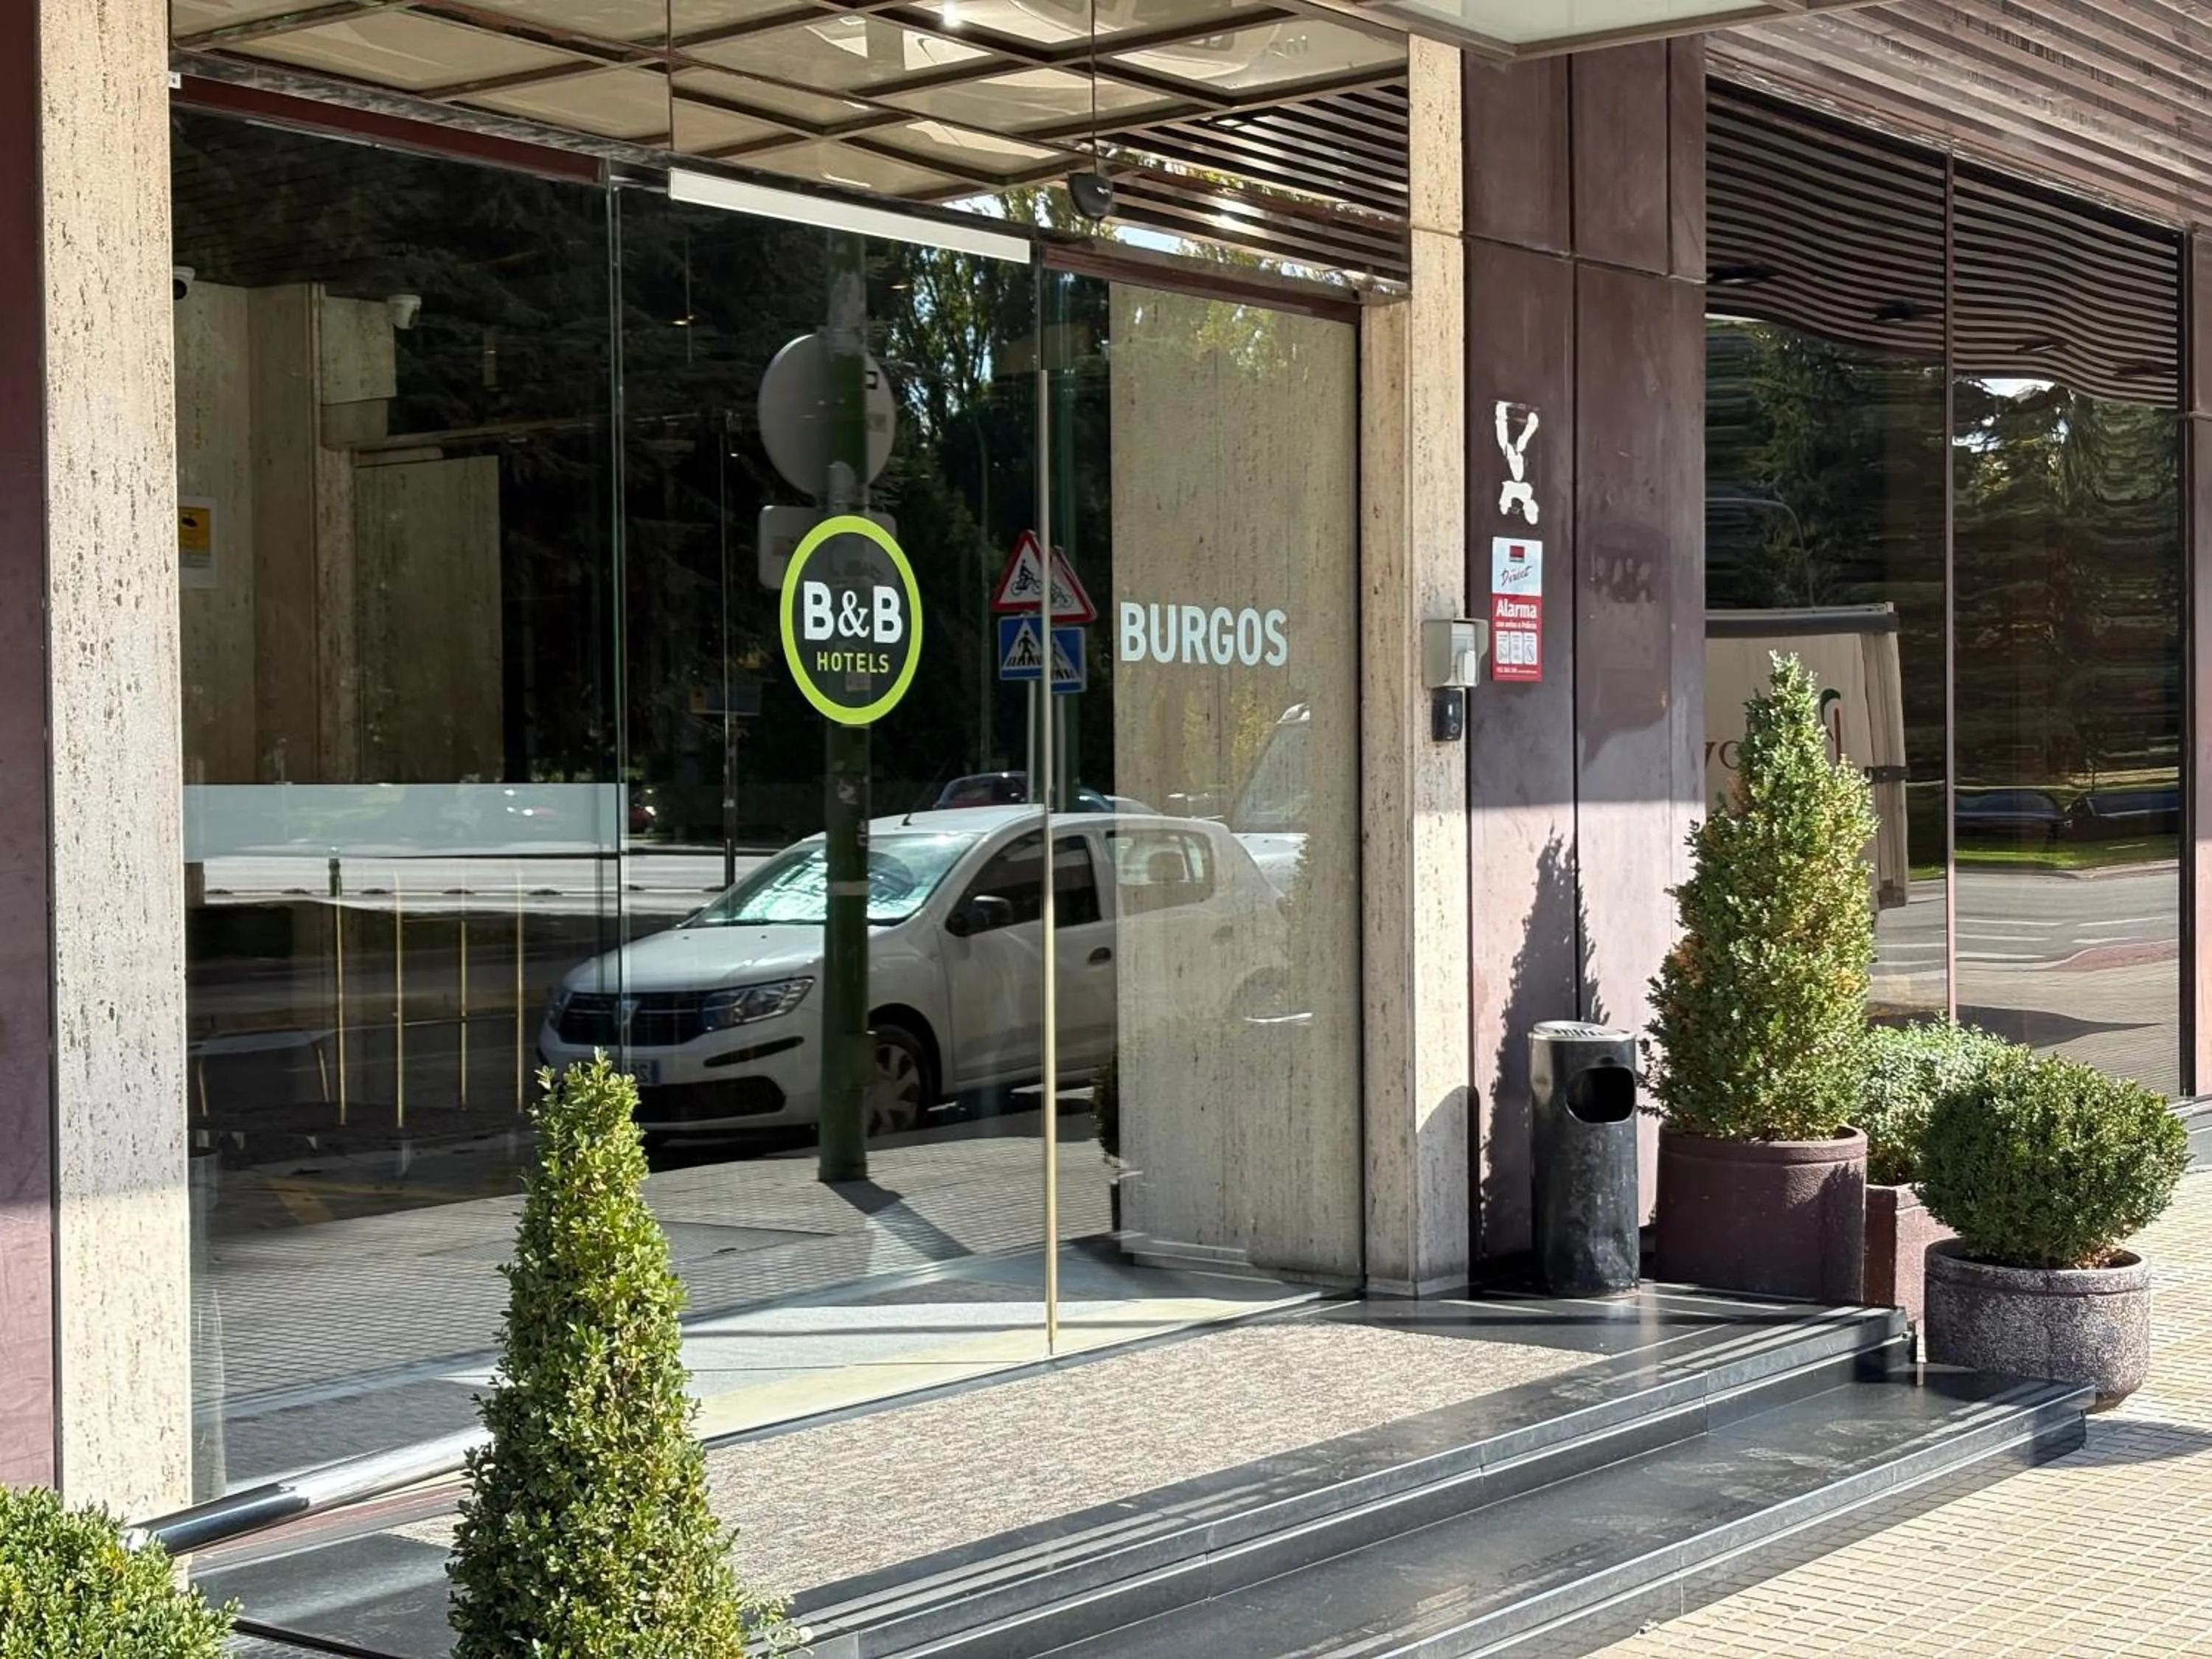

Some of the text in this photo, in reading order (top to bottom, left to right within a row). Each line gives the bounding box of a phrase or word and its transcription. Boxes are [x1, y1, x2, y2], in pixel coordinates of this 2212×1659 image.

[803, 580, 903, 644] B&B
[1495, 598, 1537, 619] Alarma
[1120, 602, 1287, 666] BURGOS
[816, 652, 889, 674] HOTELS
